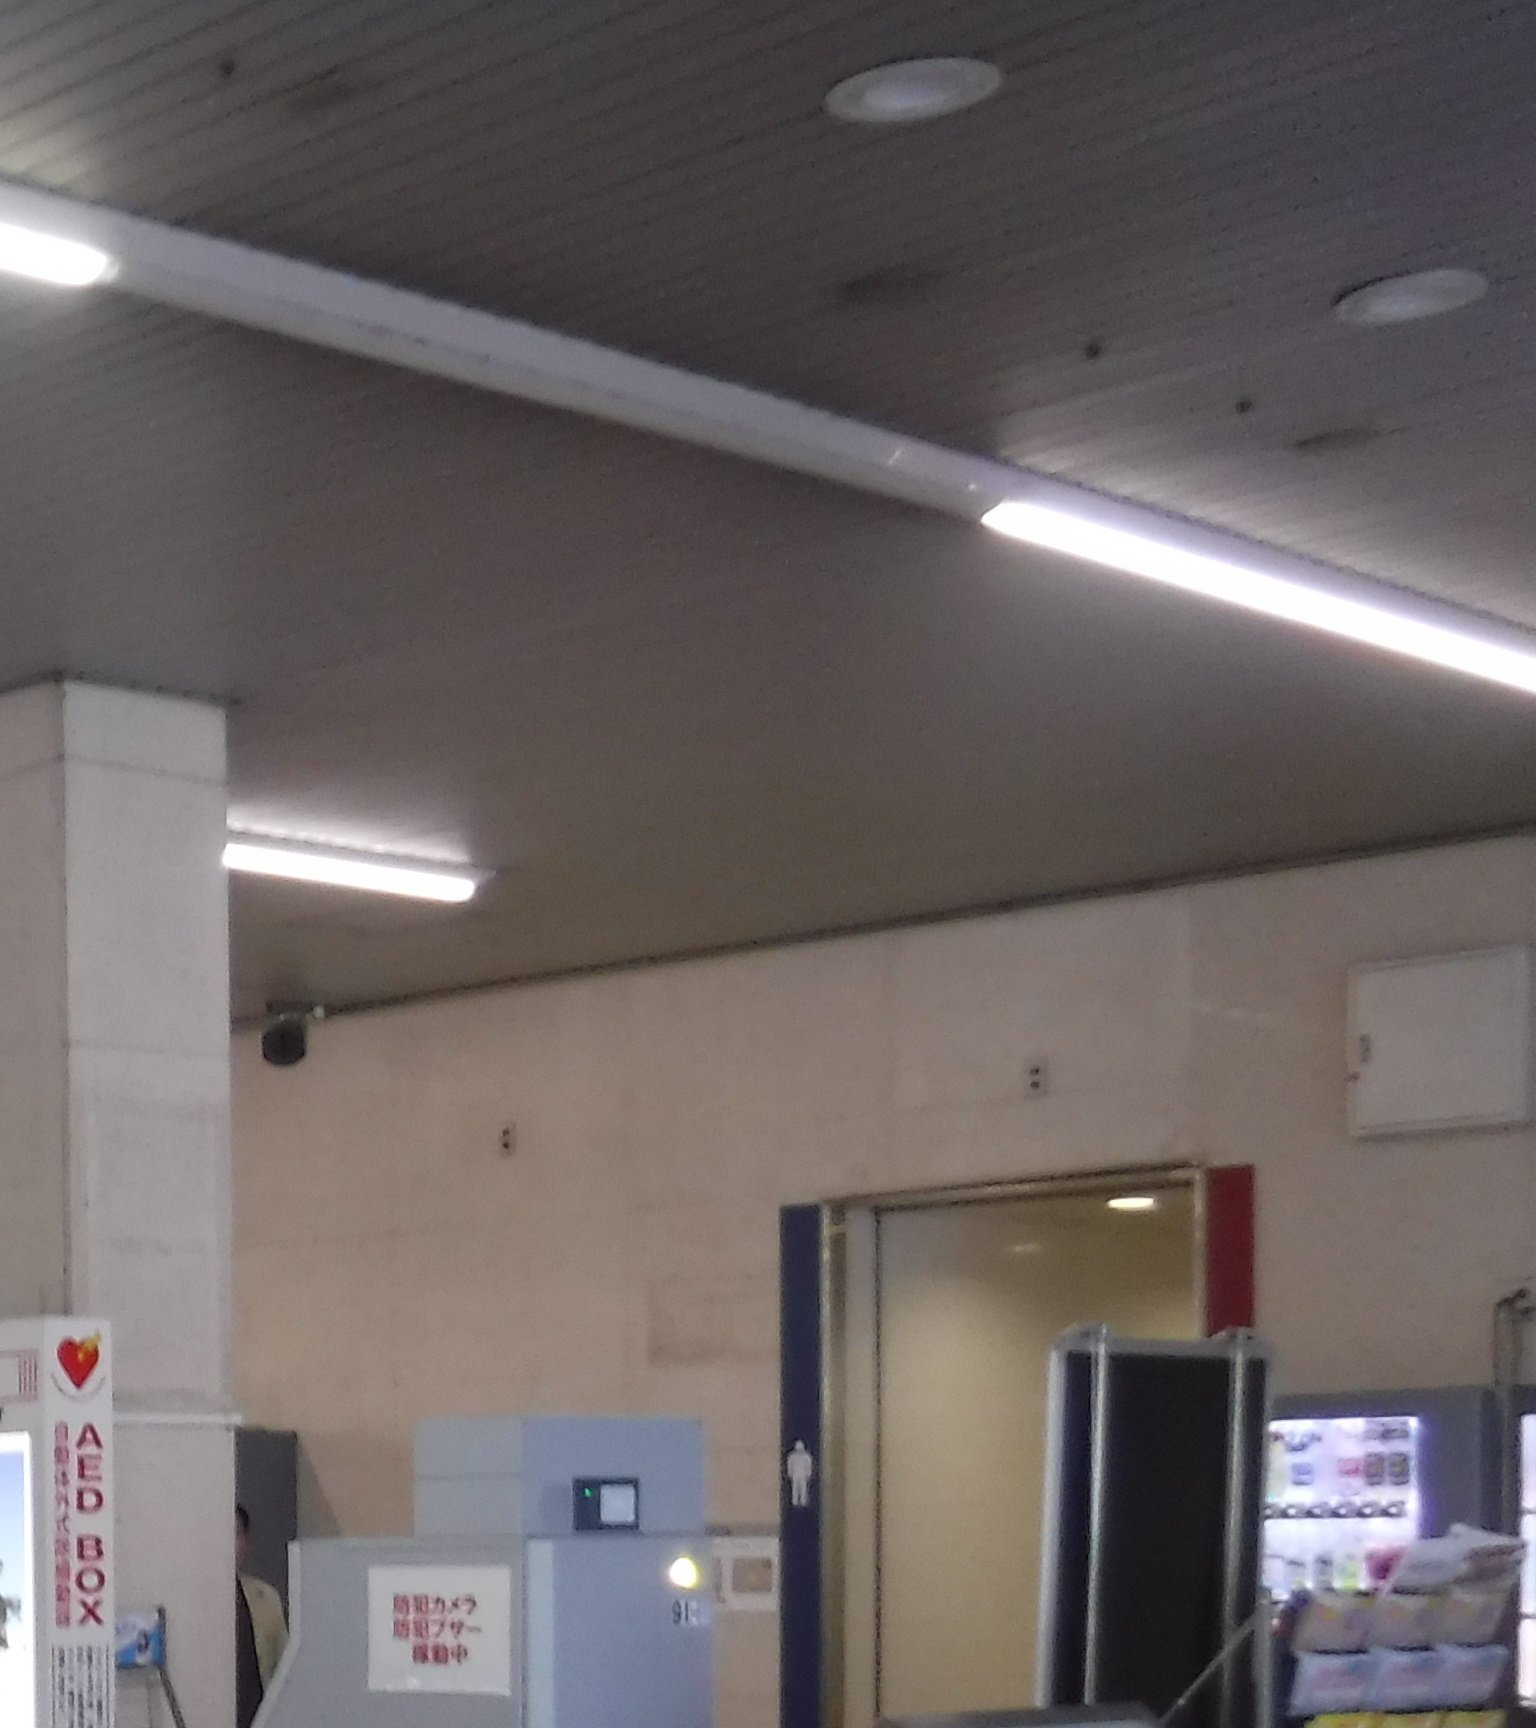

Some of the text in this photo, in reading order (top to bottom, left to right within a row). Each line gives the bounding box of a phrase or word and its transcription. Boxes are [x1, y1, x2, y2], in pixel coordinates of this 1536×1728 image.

[76, 1421, 104, 1514] AED
[75, 1532, 106, 1627] BOX
[393, 1593, 478, 1616] 防犯カメラ
[393, 1619, 482, 1642] 防犯ブザー
